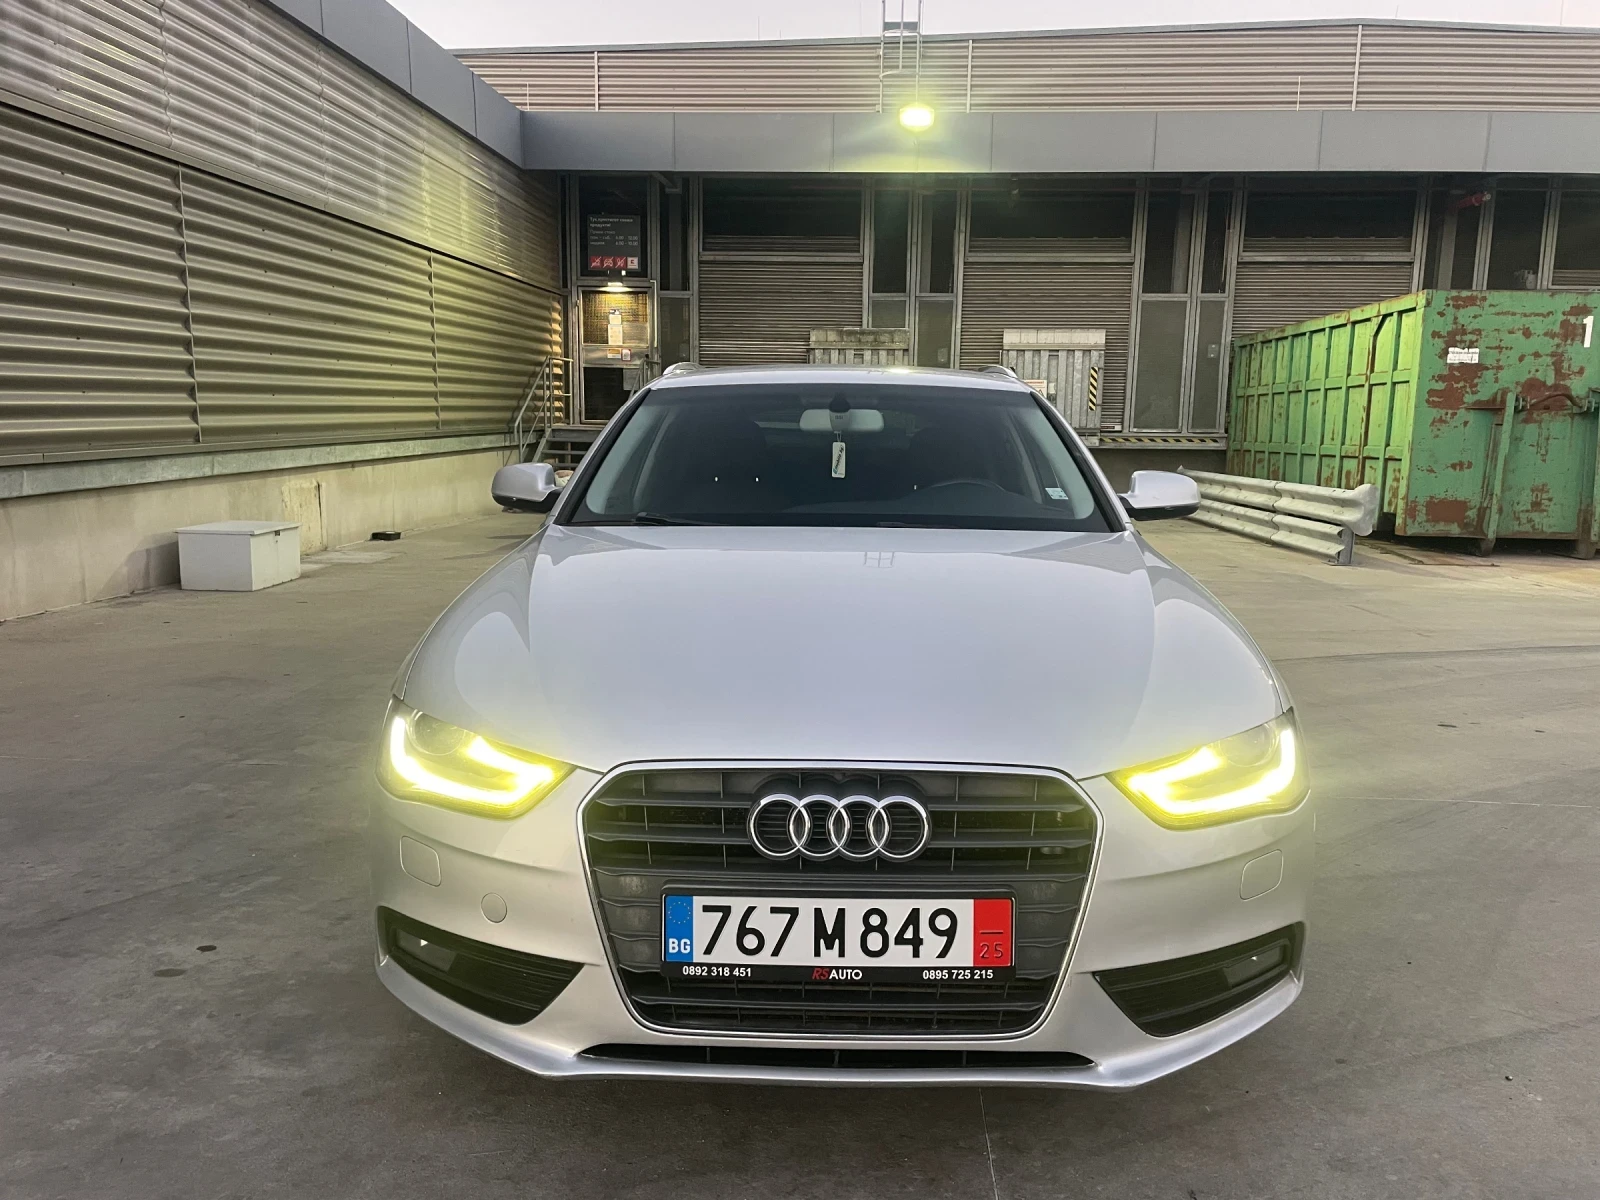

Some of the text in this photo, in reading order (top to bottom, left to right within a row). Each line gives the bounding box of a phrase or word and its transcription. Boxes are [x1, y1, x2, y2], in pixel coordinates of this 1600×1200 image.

[1583, 315, 1595, 348] 1
[702, 904, 958, 959] 767 M 849
[668, 938, 691, 954] BG
[979, 942, 1003, 959] 25
[682, 966, 752, 977] 0892 318 451
[922, 969, 994, 980] 0895 725 215
